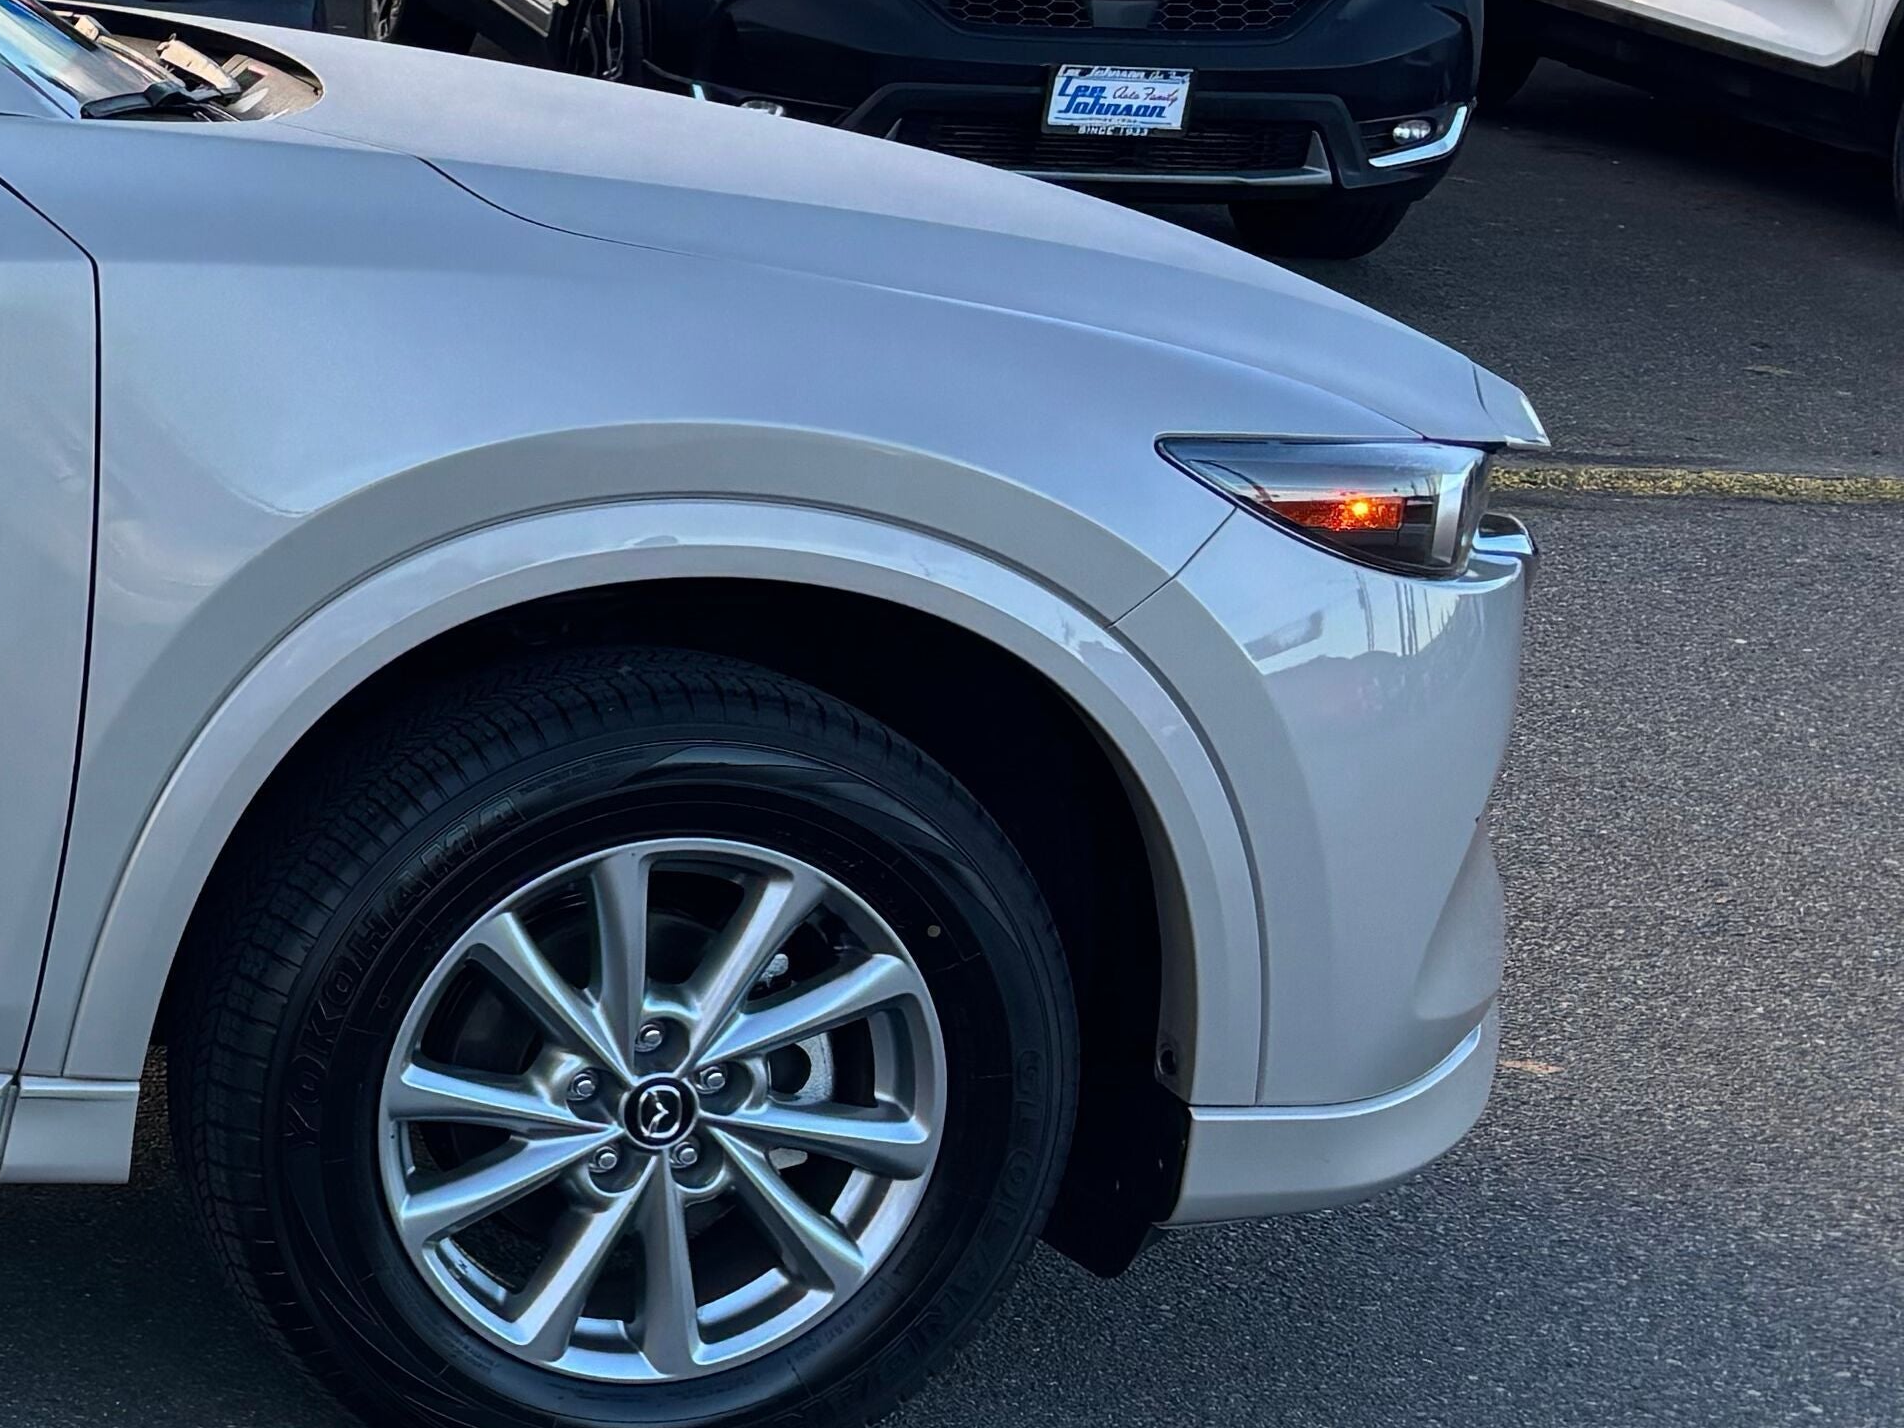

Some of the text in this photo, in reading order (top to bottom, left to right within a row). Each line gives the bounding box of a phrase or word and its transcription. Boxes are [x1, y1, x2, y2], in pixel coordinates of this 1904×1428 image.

[1058, 76, 1107, 99] Lee
[1058, 93, 1166, 119] Johnson
[285, 794, 527, 1148] YOKOHAMA
